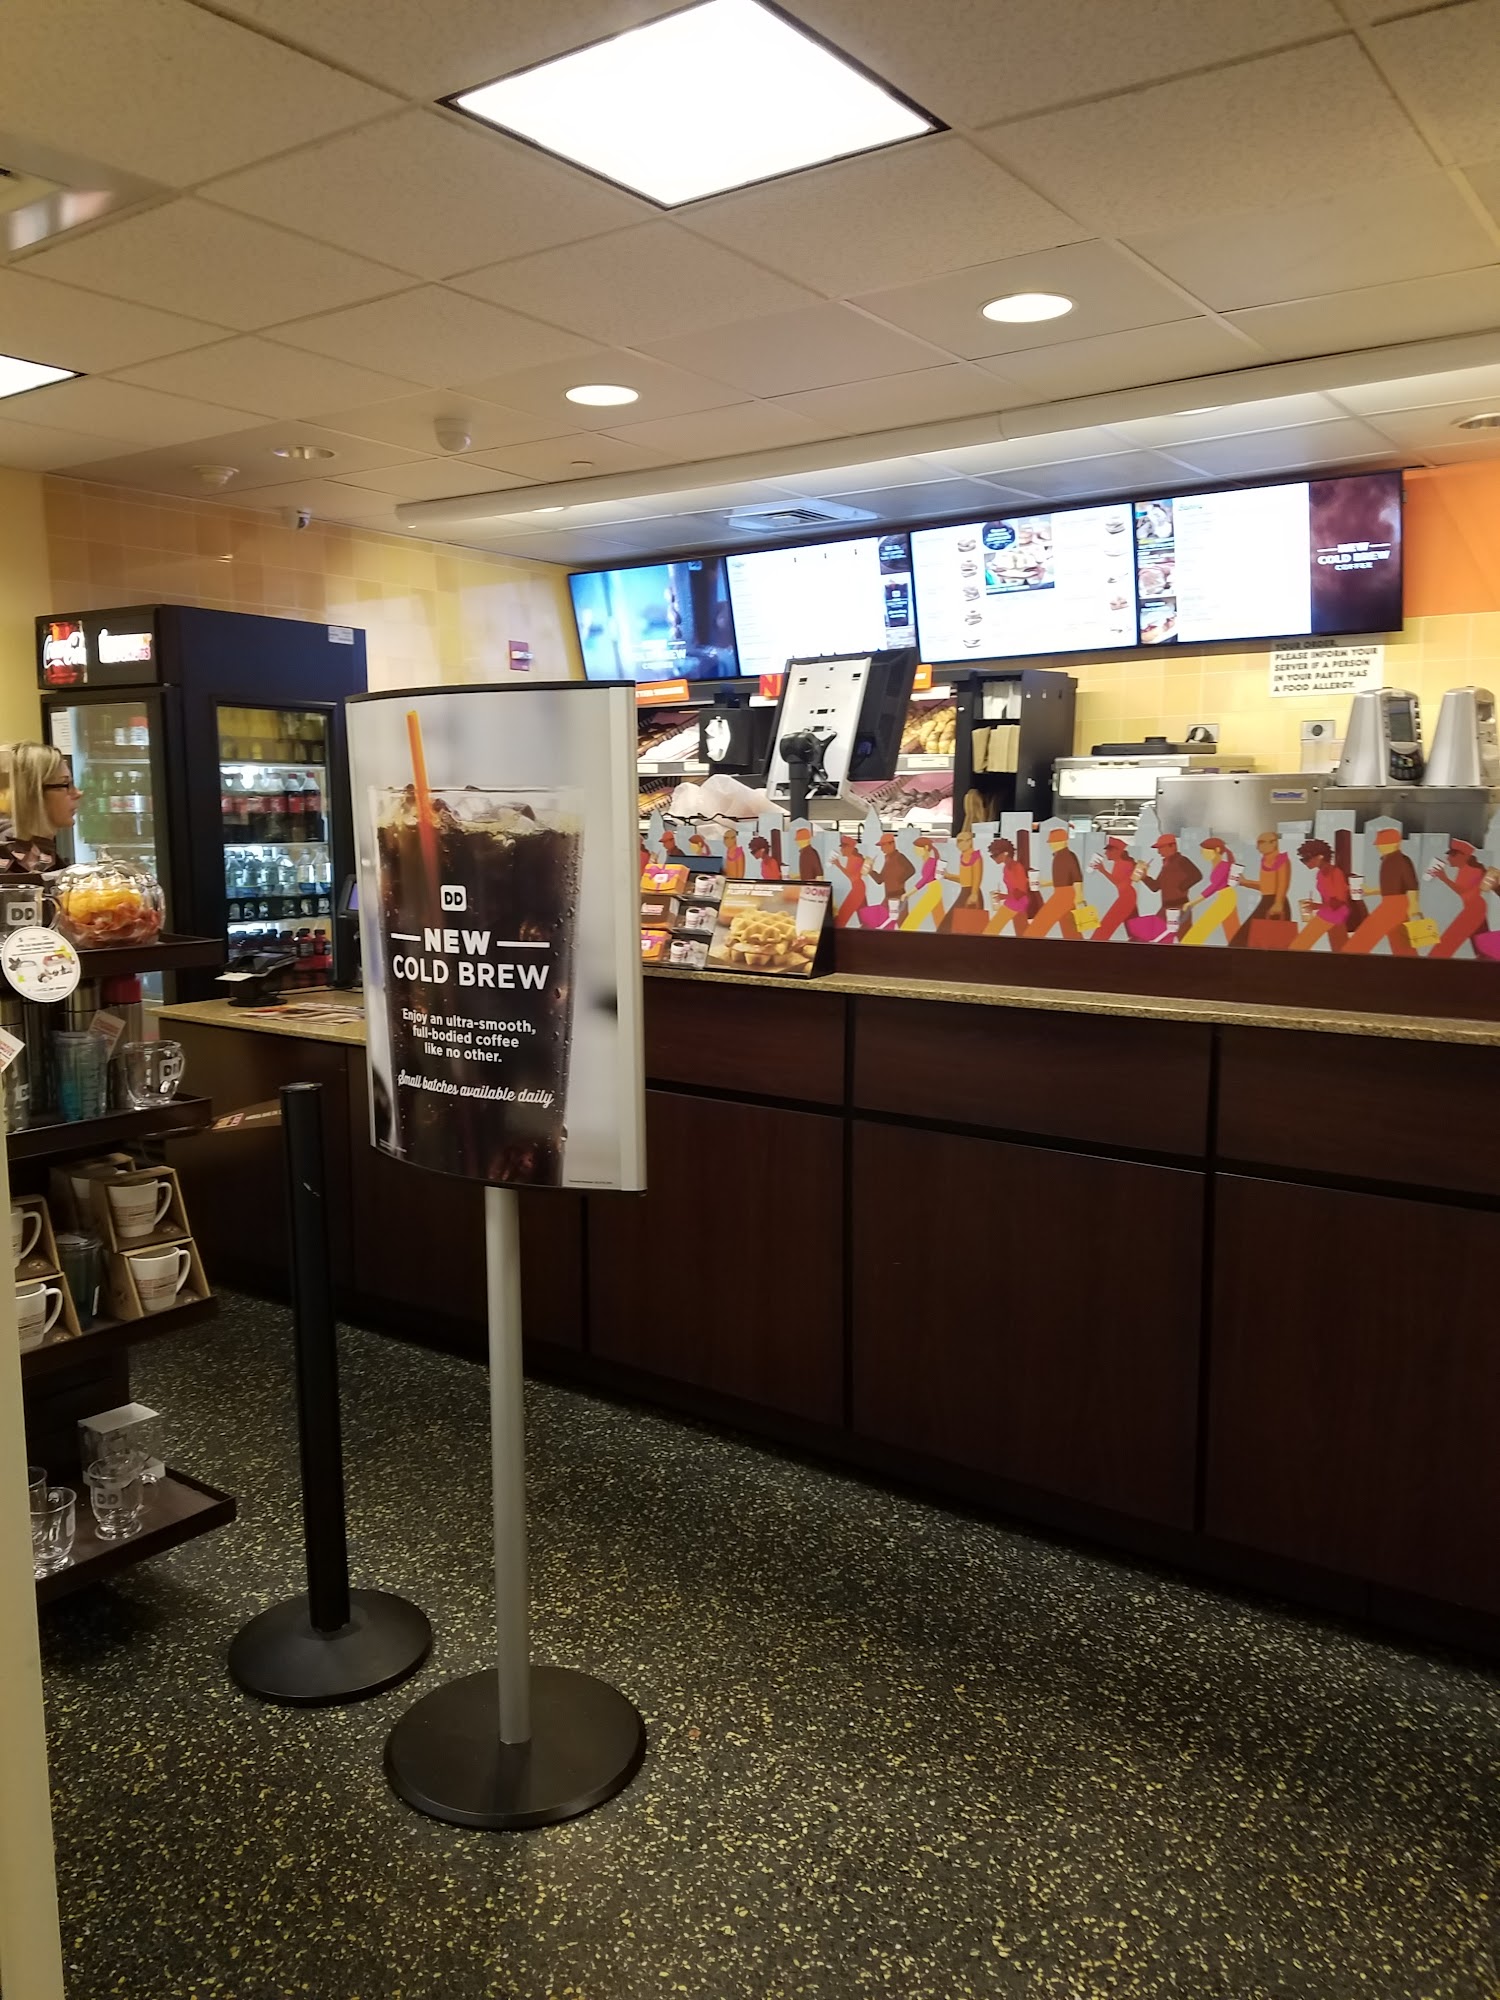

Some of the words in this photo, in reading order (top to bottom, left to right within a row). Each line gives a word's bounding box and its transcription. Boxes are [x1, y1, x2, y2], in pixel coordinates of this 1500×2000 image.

[1275, 652, 1308, 660] PLEASE
[1311, 649, 1348, 658] INFORM
[1352, 647, 1378, 655] YOUR
[1274, 662, 1308, 671] SERVER
[1332, 659, 1370, 667] PERSON
[1286, 673, 1312, 681] YOUR
[1315, 671, 1345, 679] PARTY
[1348, 669, 1367, 677] HAS
[1283, 683, 1309, 691] FOOD
[444, 892, 463, 906] DD
[11, 907, 35, 921] DD
[424, 928, 491, 955] NEW
[393, 955, 449, 984] COLD
[458, 962, 549, 990] BREW
[402, 1008, 427, 1024] Enjoy
[430, 1014, 443, 1026] an
[445, 1015, 536, 1035] ultra-smooth,
[413, 1025, 471, 1044] full-bodied
[475, 1034, 519, 1048] coffee
[424, 1042, 443, 1056] like
[446, 1046, 460, 1058] no
[464, 1048, 502, 1062] other.
[398, 1069, 423, 1090] Small
[422, 1075, 459, 1095] batches
[459, 1085, 516, 1101] available
[517, 1088, 554, 1109] daily
[97, 1493, 118, 1505] DD
